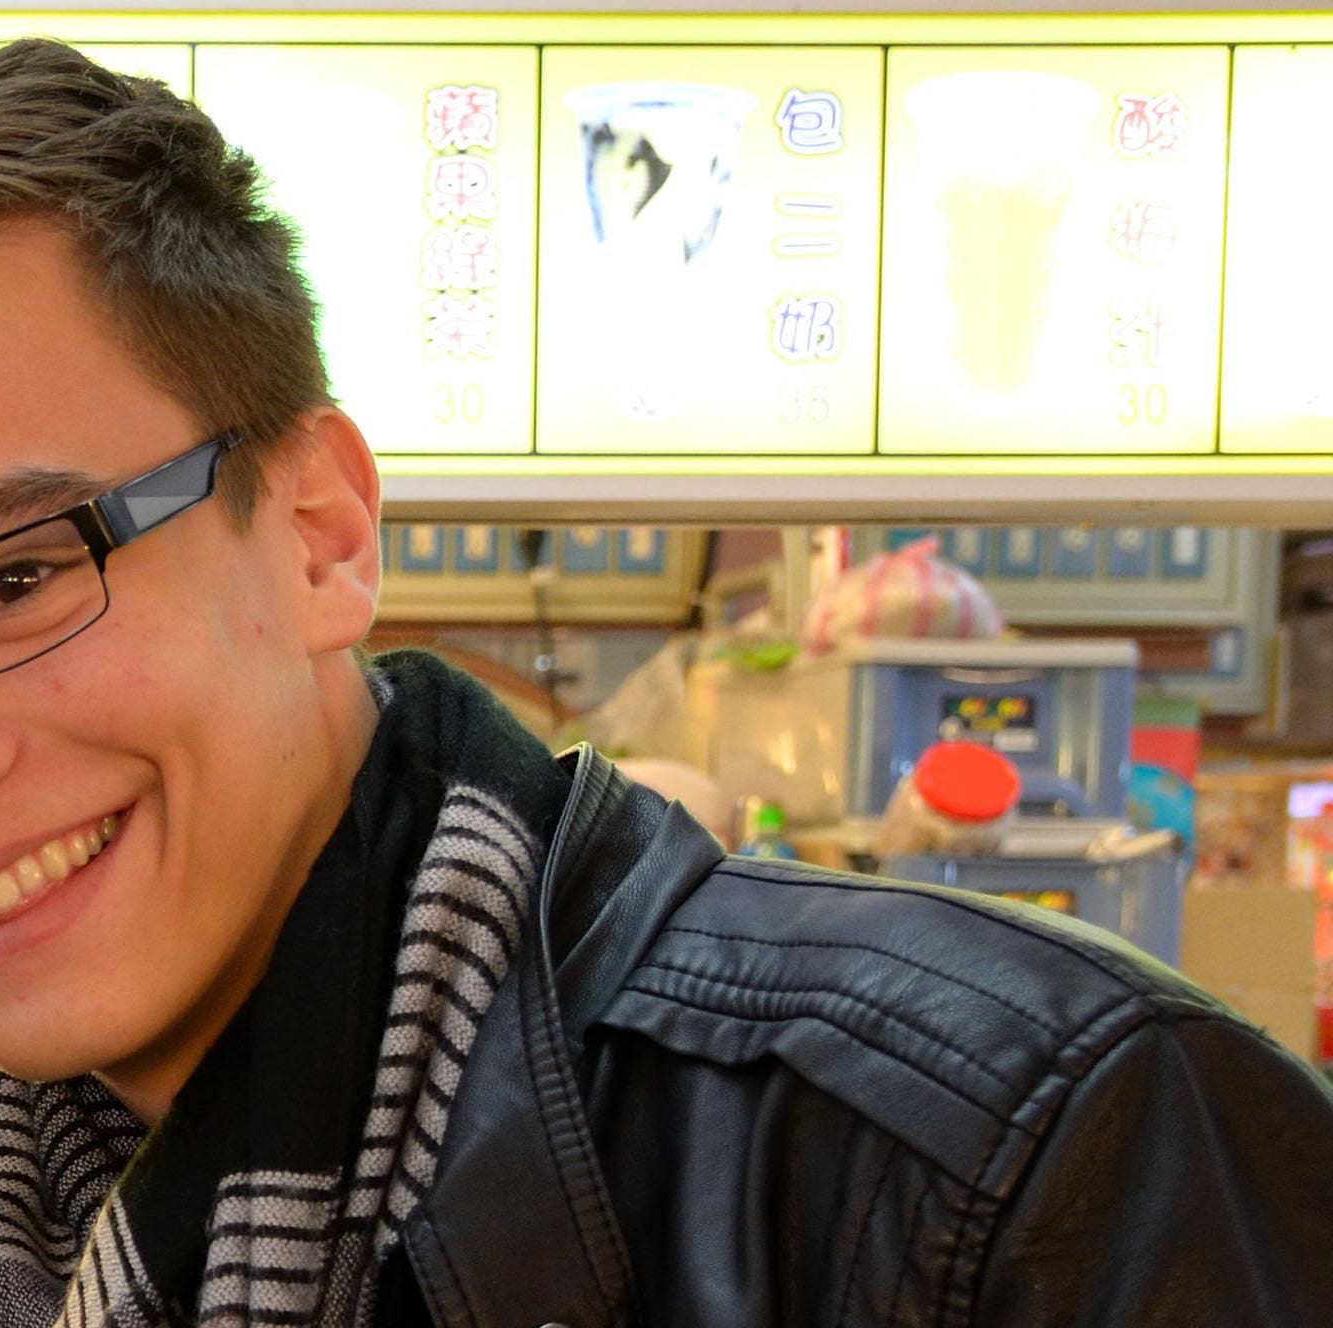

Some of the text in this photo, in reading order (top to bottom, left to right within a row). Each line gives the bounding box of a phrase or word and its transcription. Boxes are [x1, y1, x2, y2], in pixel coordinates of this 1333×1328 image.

[773, 89, 842, 360] 包二奶
[433, 385, 485, 425] 30
[779, 386, 831, 425] 35
[1117, 384, 1169, 426] 30
